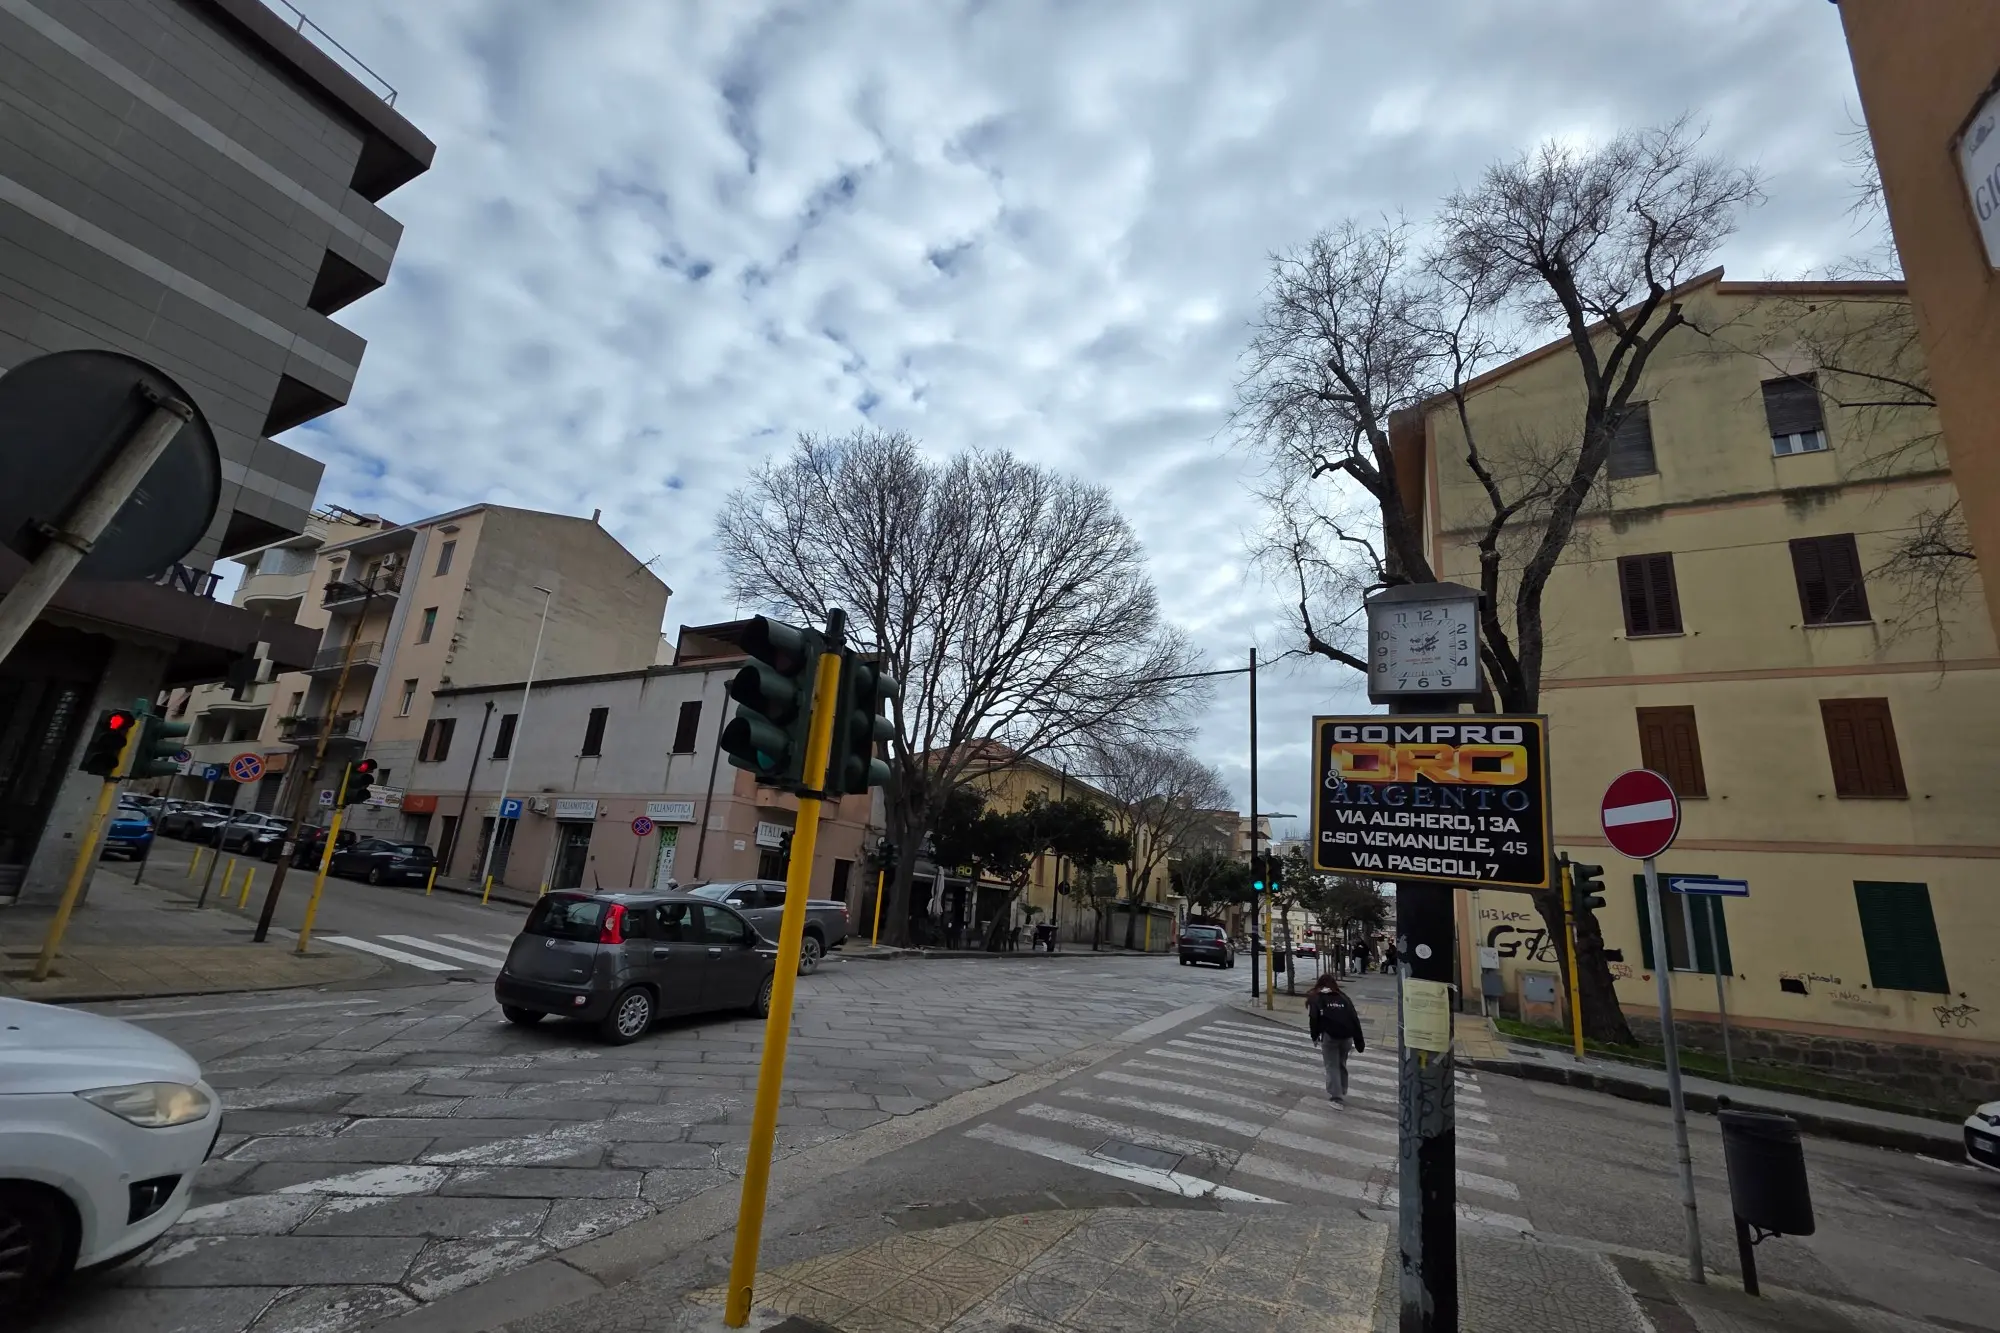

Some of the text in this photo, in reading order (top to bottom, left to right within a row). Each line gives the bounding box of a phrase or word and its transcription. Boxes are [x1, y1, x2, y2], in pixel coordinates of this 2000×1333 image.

[1394, 612, 1407, 623] 11
[1417, 609, 1433, 621] 12
[1441, 608, 1448, 619] 1
[1456, 623, 1468, 635] 2
[1376, 630, 1390, 641] 10
[1377, 646, 1389, 657] 9
[1457, 640, 1468, 651] 3
[1457, 656, 1469, 667] 4
[1376, 662, 1388, 674] 8
[1398, 678, 1408, 690] 7
[1417, 677, 1430, 688] 6
[1441, 675, 1452, 687] 5
[1333, 725, 1524, 744] COMPRO
[1330, 743, 1529, 786] ORO
[205, 768, 217, 779] P
[1325, 769, 1348, 790] &
[1330, 783, 1530, 812] ARGENTO
[504, 800, 518, 816] P
[648, 803, 691, 814] ITALIANOTTICA
[1335, 809, 1367, 825] VIA
[1360, 830, 1495, 857] V.EMANUELE,
[1502, 841, 1528, 856] 45
[666, 849, 672, 858] E
[1351, 852, 1500, 880] VIA PASCOLI, 7
